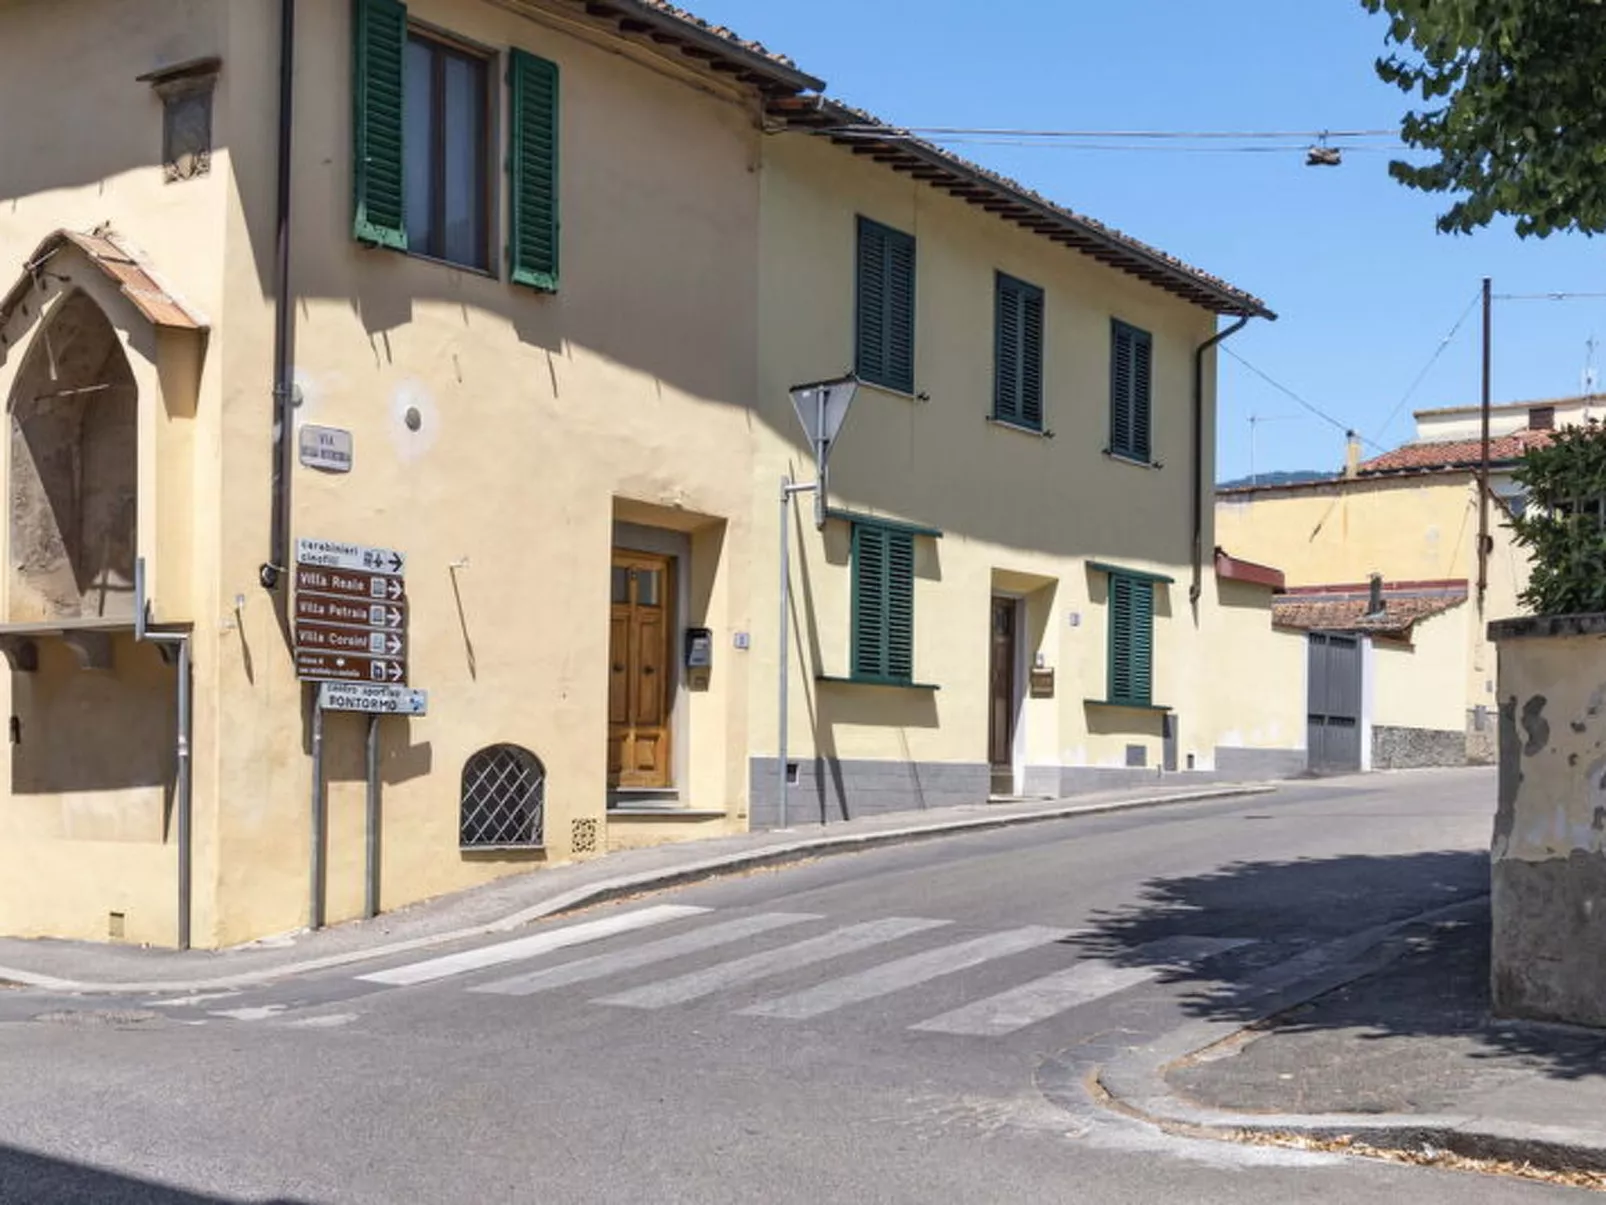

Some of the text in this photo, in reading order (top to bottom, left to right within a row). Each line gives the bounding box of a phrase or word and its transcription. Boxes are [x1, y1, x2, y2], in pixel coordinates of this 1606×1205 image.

[319, 434, 334, 446] VIA
[299, 572, 365, 591] Villa Reale
[299, 601, 367, 619] Villa Petraia
[299, 629, 367, 647] Villa Corsini
[329, 695, 397, 711] PONTORMO
